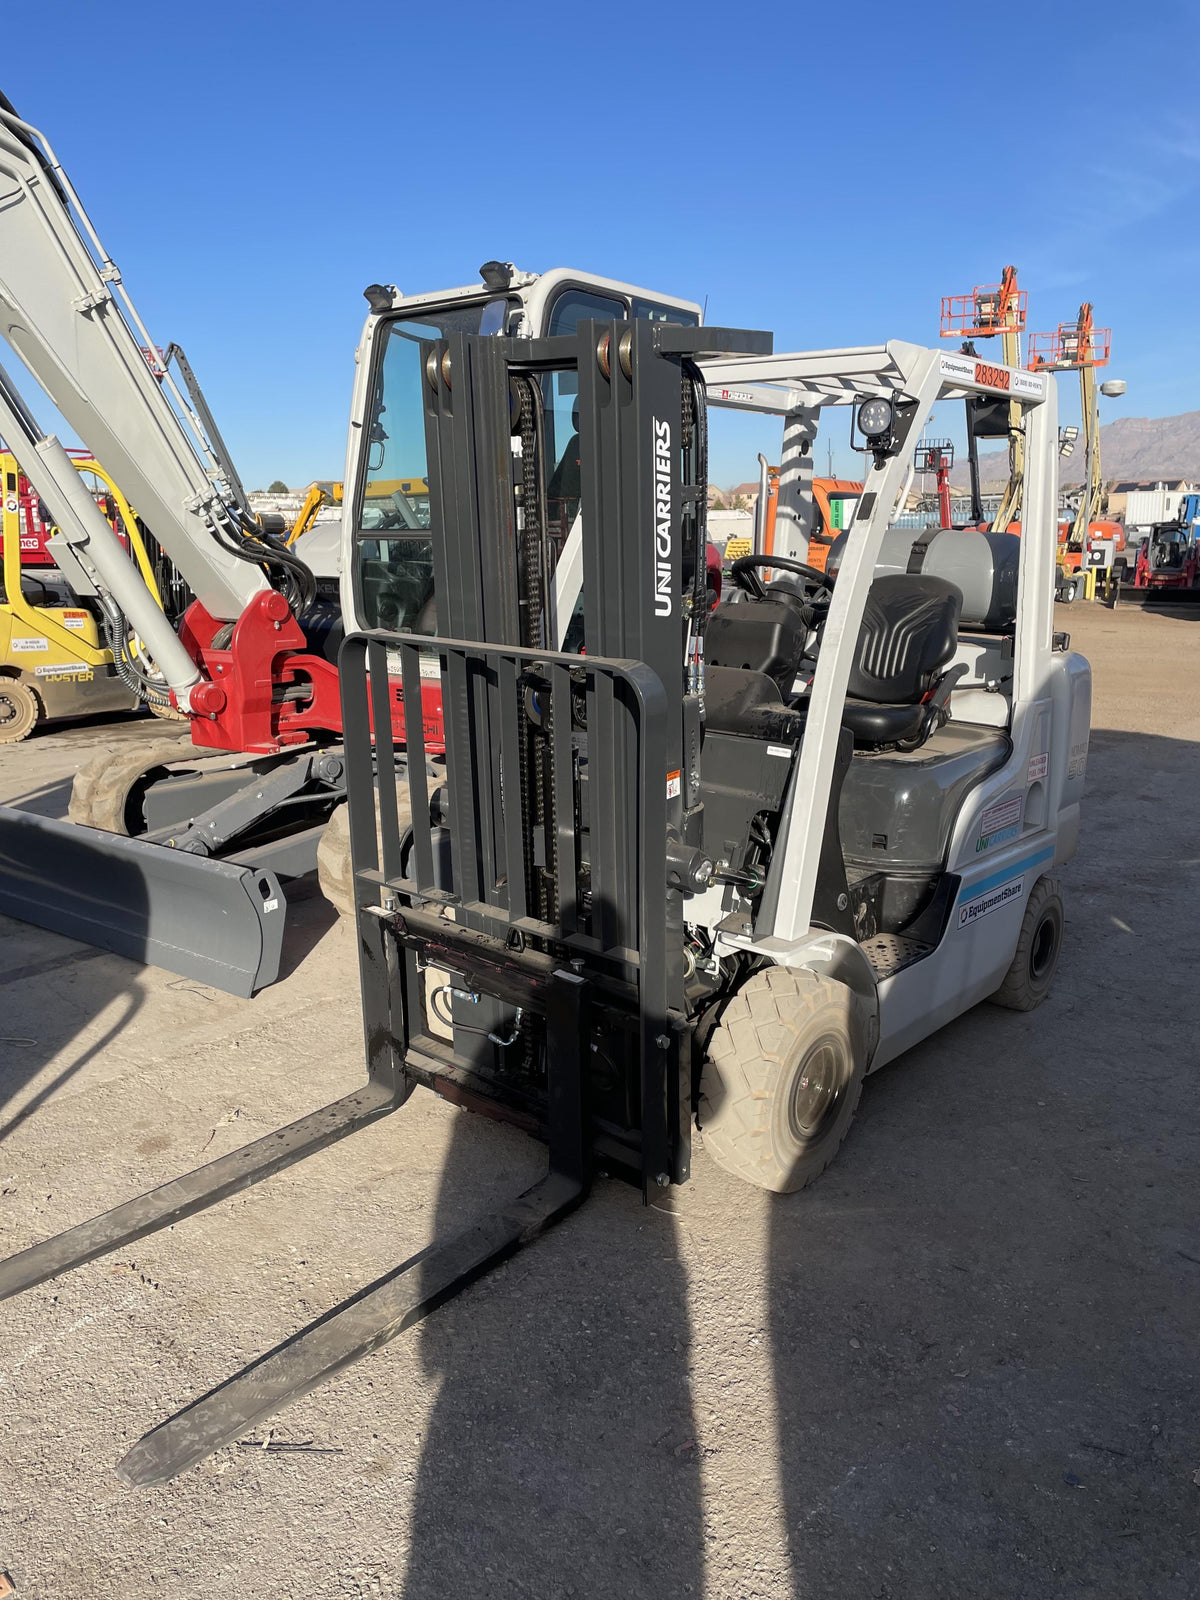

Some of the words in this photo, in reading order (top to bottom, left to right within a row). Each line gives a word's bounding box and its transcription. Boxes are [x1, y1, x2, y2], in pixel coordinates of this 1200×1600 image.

[945, 361, 973, 375] EquipmentShare
[975, 363, 1009, 391] 283292
[653, 415, 672, 617] UNICARRIERS
[968, 884, 1022, 917] EquipmentShare
